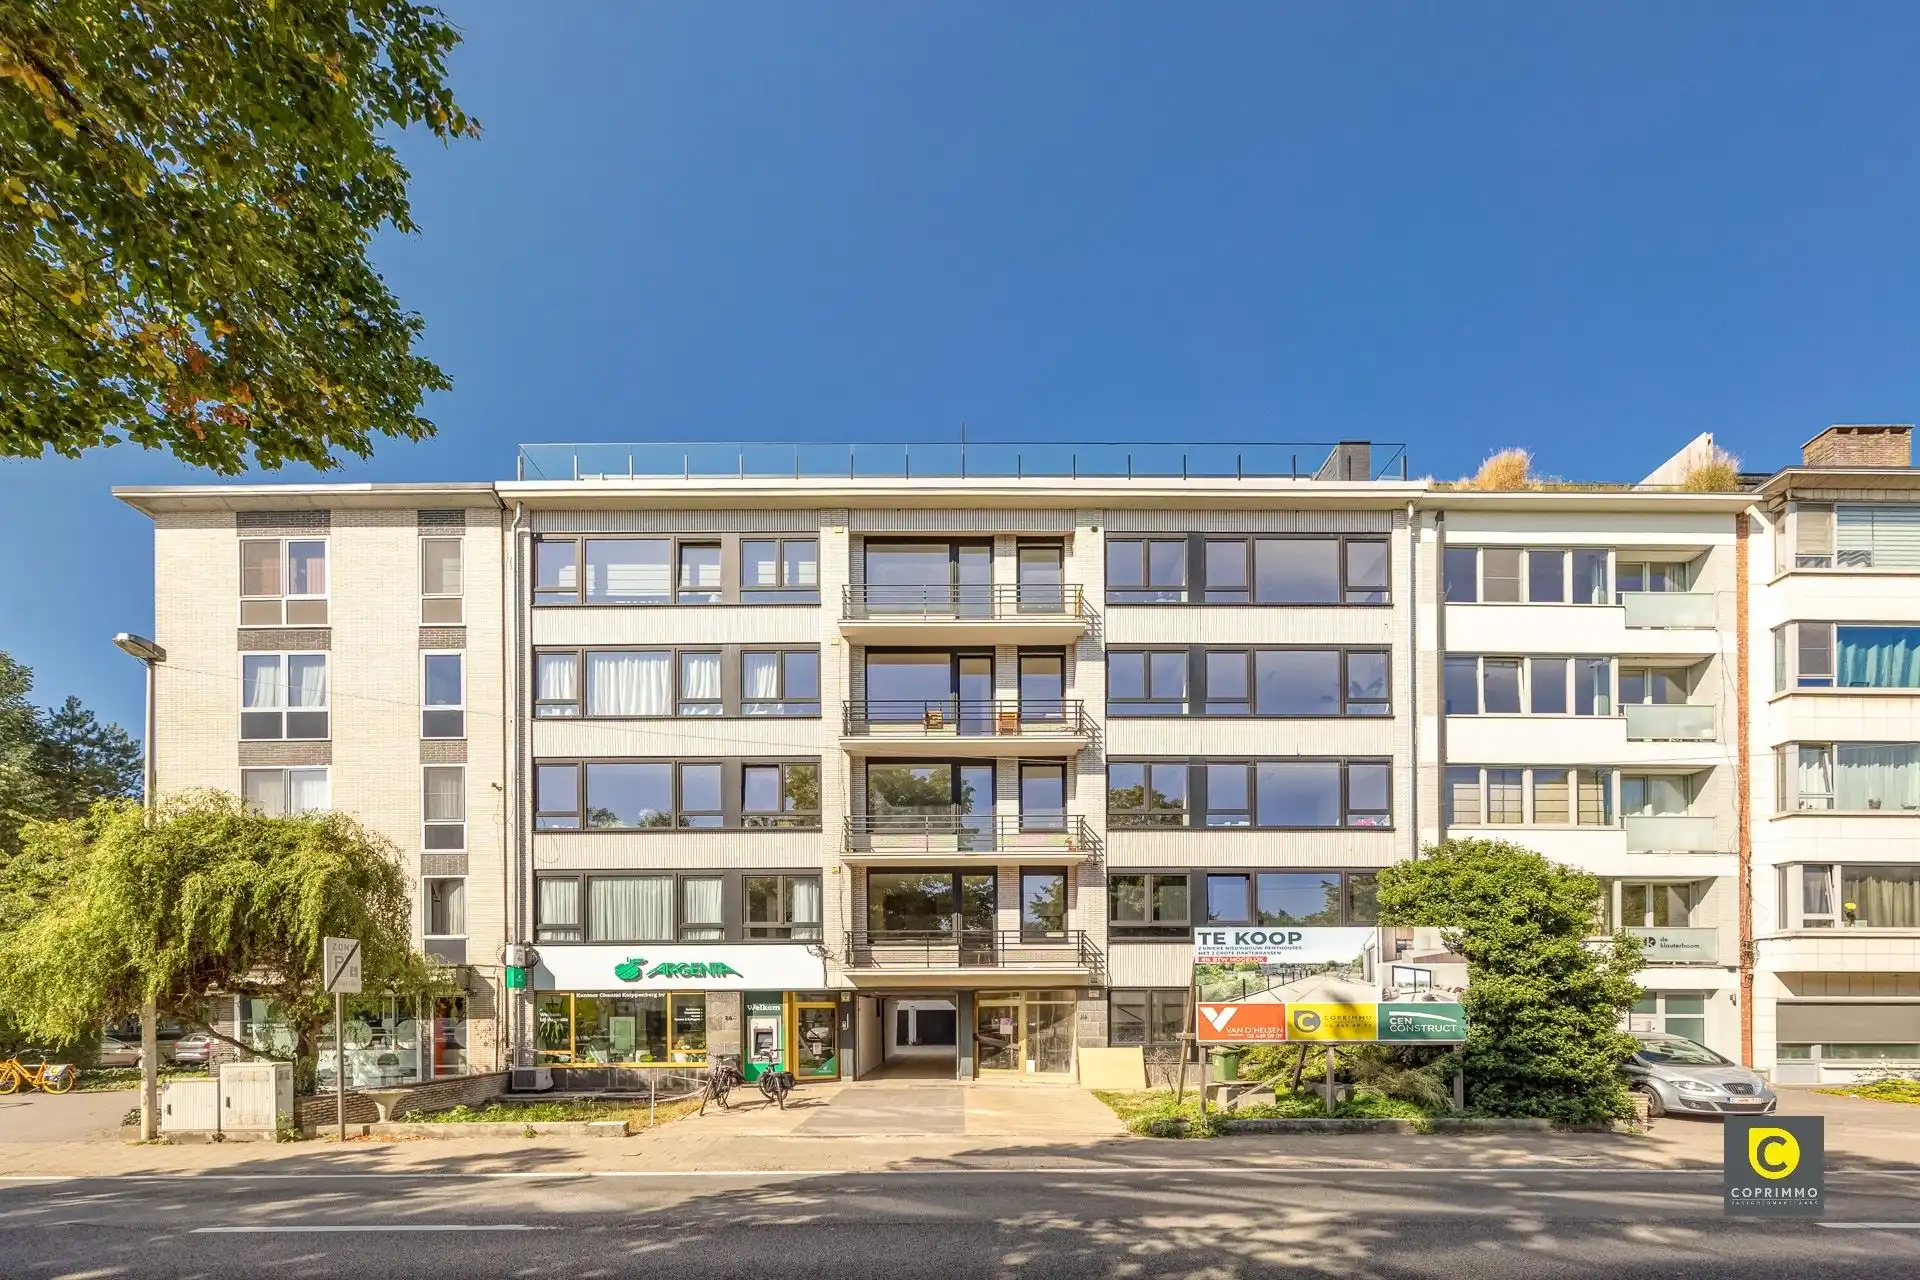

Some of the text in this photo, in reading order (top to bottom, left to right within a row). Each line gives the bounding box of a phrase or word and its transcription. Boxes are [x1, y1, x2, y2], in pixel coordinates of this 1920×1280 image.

[1197, 931, 1302, 945] TE KOOP
[646, 962, 744, 979] ARGENTA
[747, 1003, 781, 1011] Welkom
[1389, 1017, 1413, 1025] CEN
[1389, 1024, 1458, 1033] CONSTRUCT
